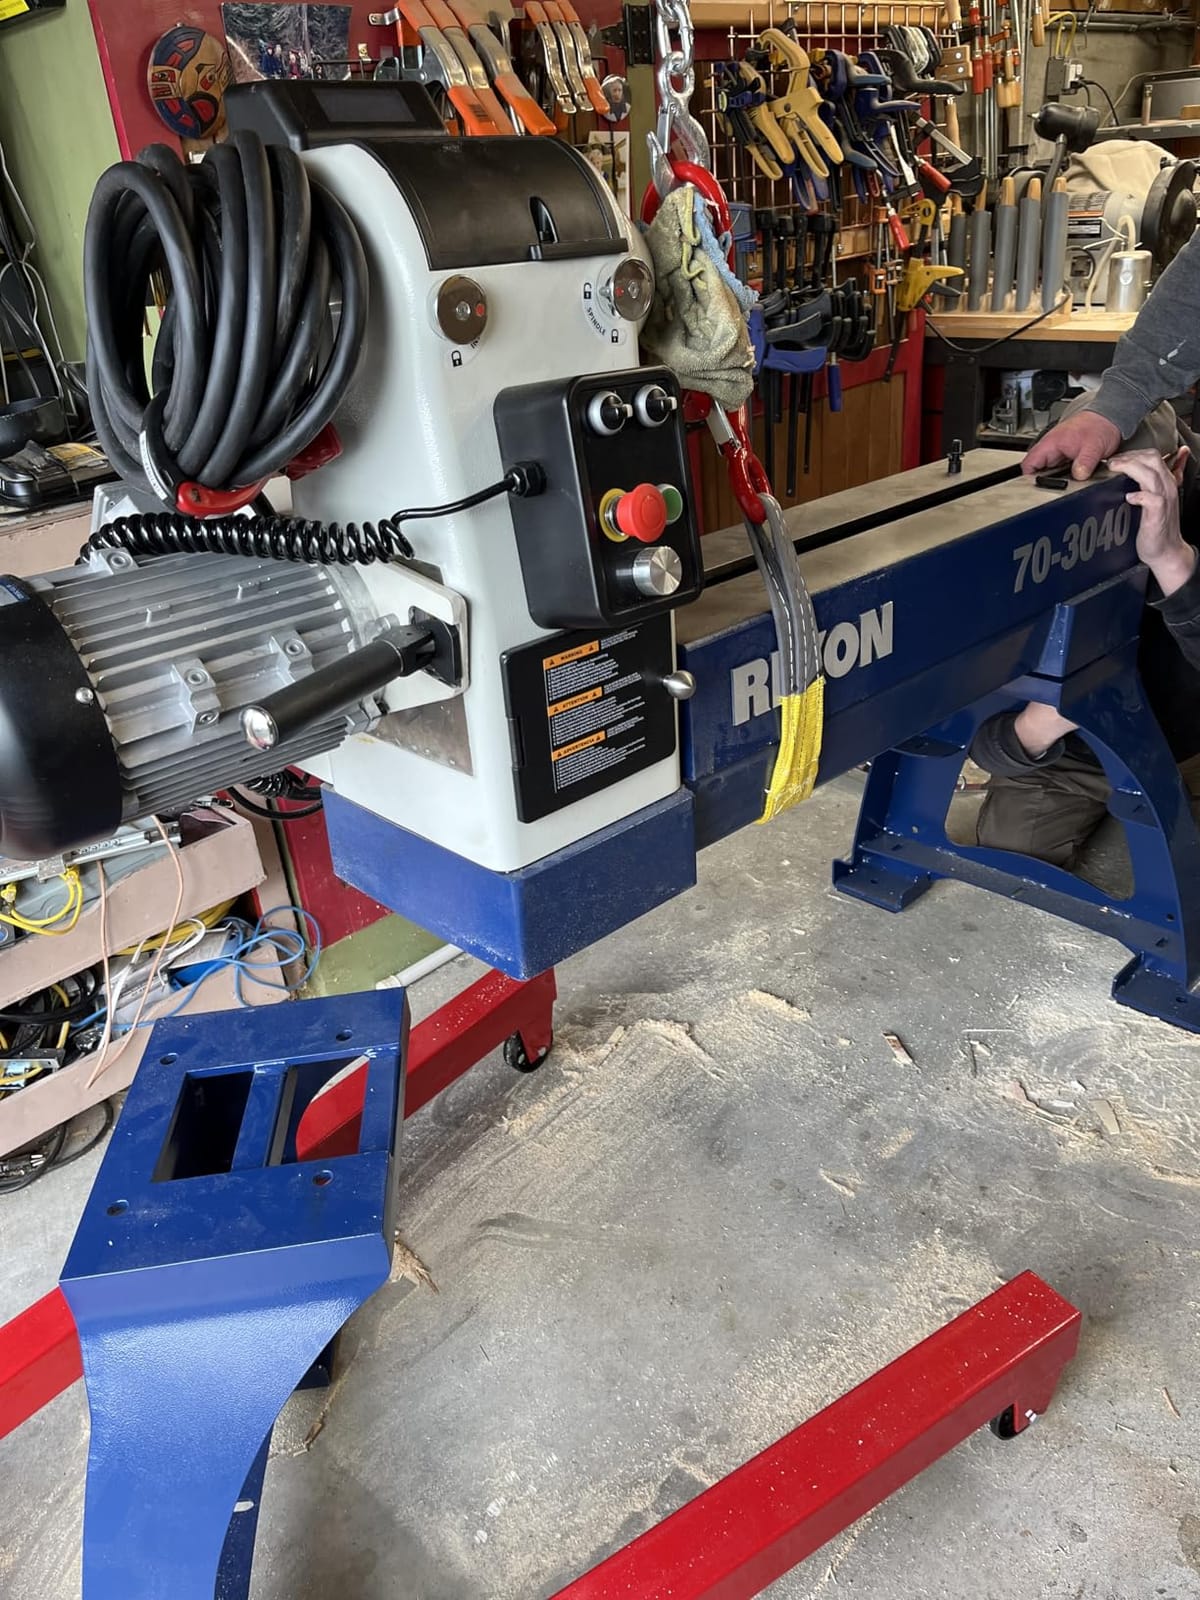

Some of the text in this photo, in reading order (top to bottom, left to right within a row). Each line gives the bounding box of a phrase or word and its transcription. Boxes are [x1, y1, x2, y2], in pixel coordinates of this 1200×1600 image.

[587, 306, 606, 336] SPINDLE
[1012, 503, 1131, 594] 70-3040
[560, 648, 584, 661] WARNING
[731, 600, 894, 727] RION
